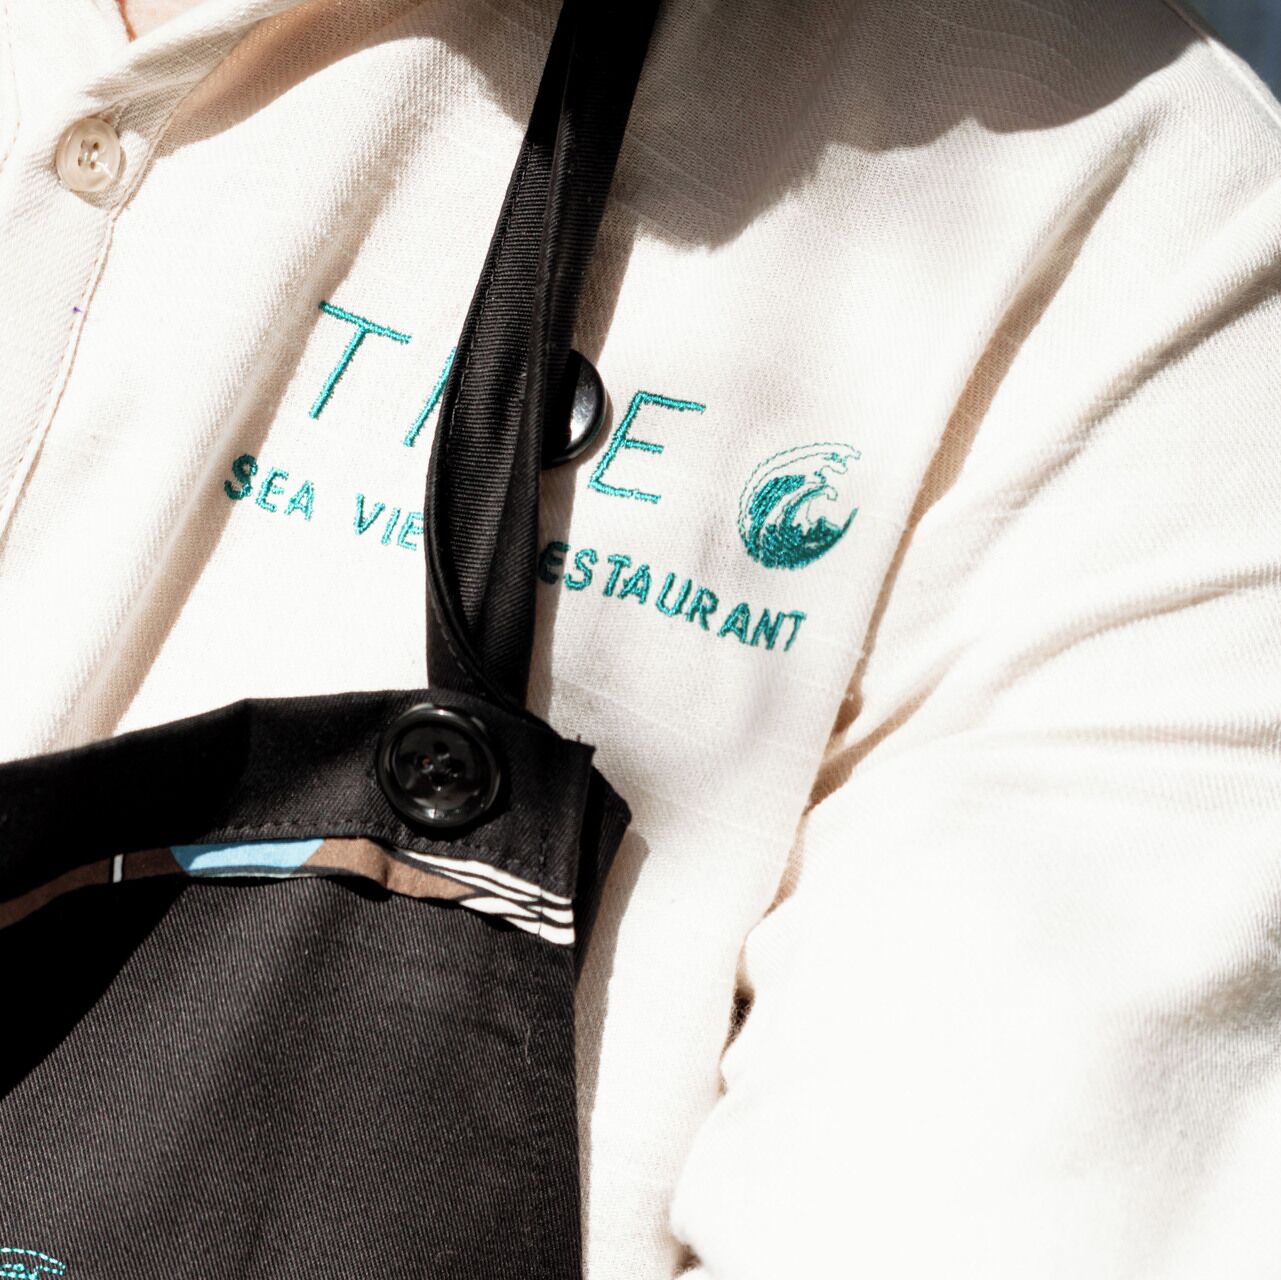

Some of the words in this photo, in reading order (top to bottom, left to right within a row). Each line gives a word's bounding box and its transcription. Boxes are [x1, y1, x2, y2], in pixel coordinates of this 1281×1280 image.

[308, 302, 707, 505] TIE
[223, 454, 316, 522] SEA
[353, 492, 426, 551] VIE
[537, 541, 808, 652] ESTAURANT
